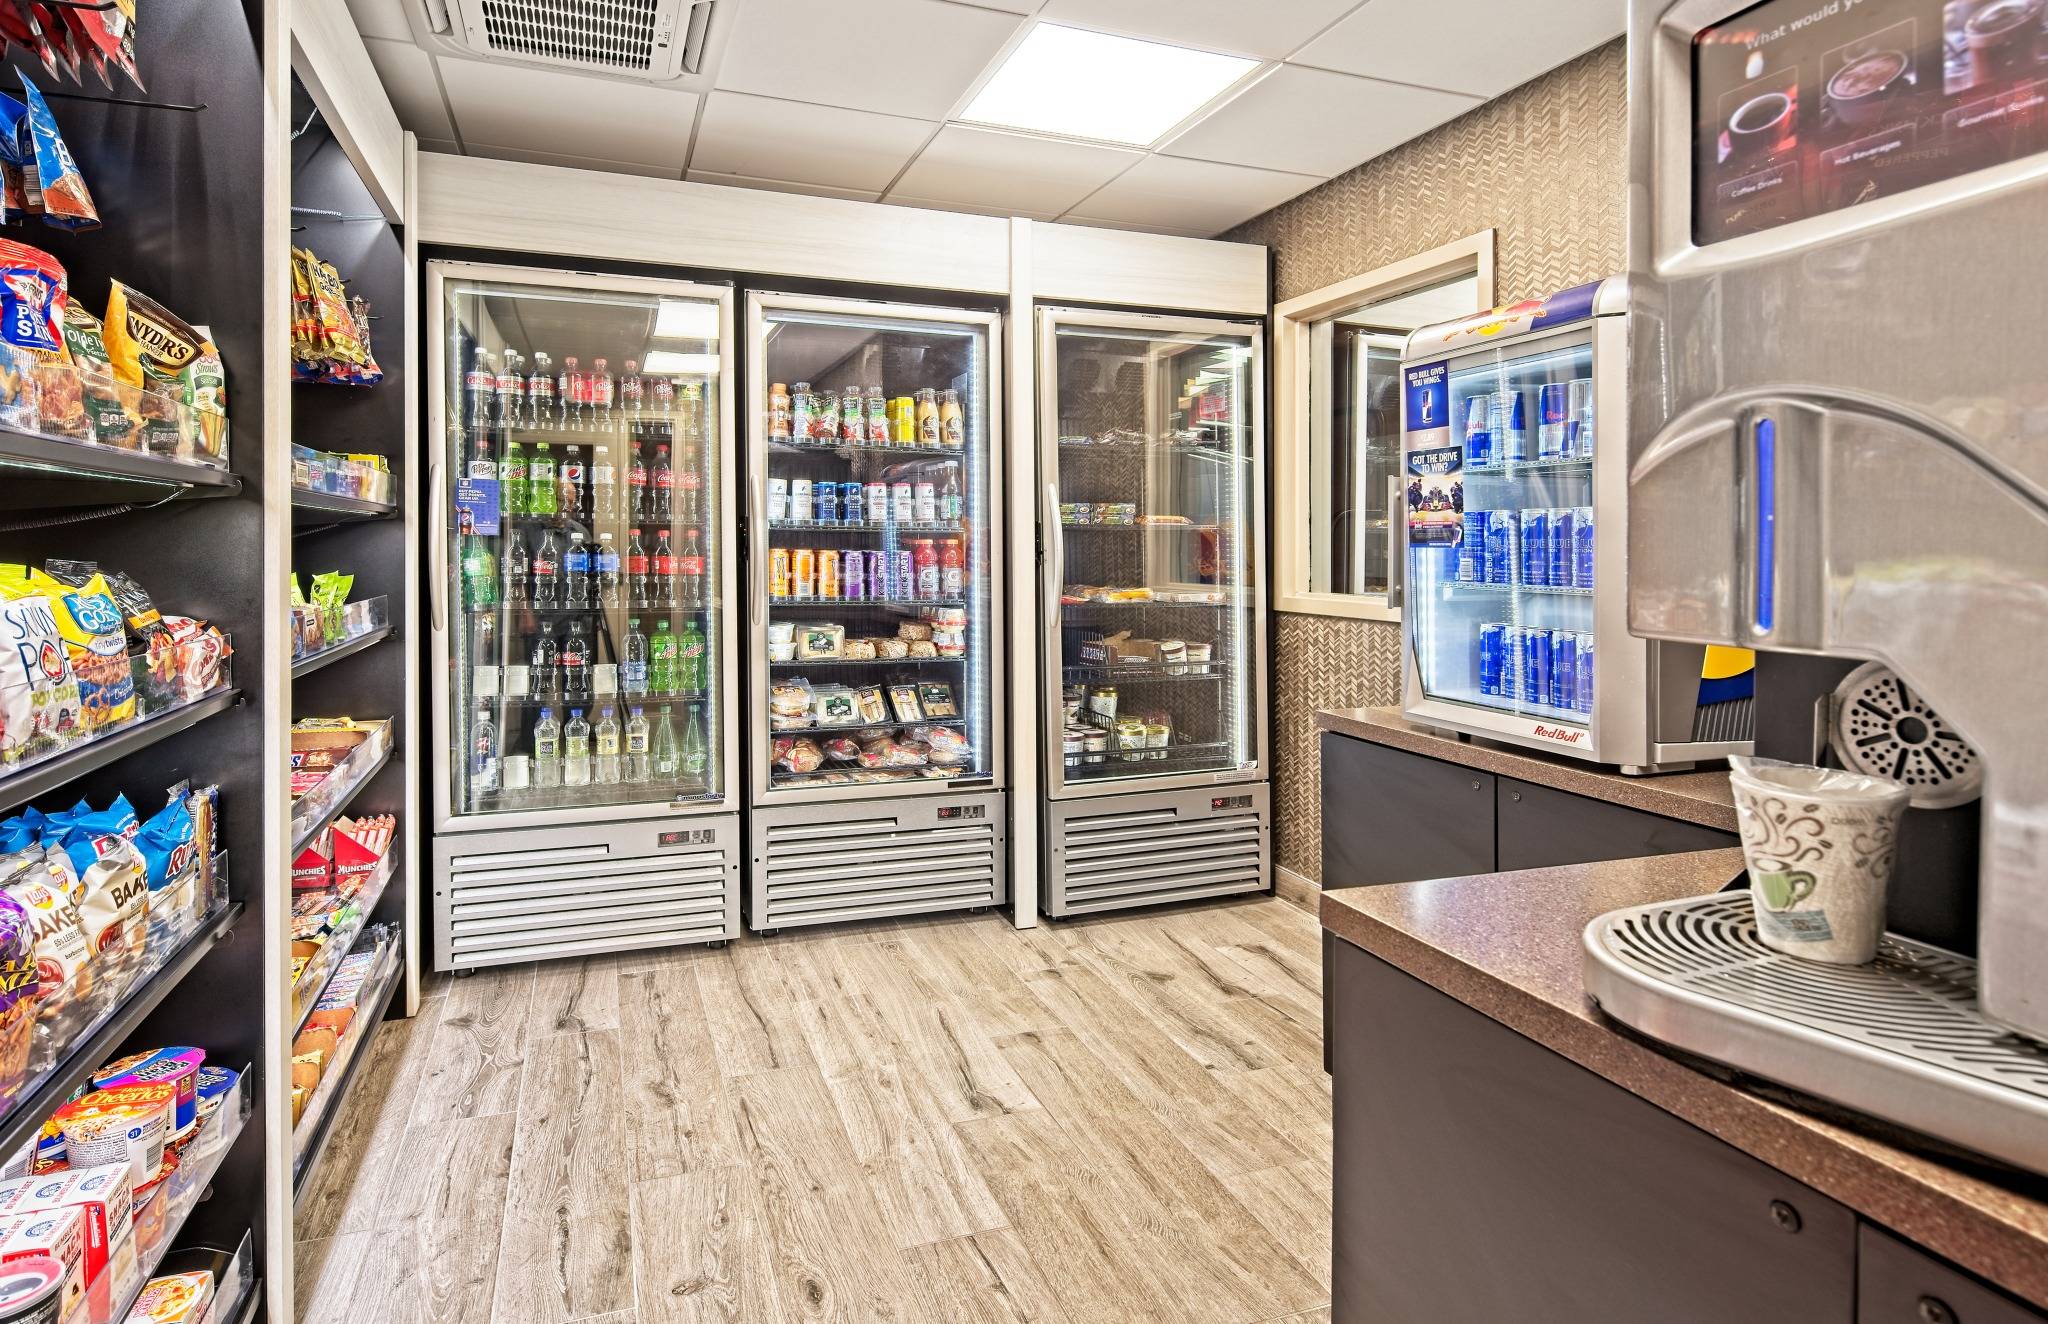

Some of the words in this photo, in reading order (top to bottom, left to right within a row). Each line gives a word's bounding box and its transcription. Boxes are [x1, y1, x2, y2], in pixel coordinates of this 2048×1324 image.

[1746, 25, 1787, 50] What
[1790, 1, 1840, 31] would
[1731, 186, 1757, 198] Coffee
[1408, 373, 1419, 381] RED
[1419, 369, 1430, 379] BULL
[1431, 366, 1445, 377] GIVES
[1412, 378, 1423, 388] YOU
[1412, 456, 1425, 465] GOT
[1427, 453, 1438, 463] THE
[1439, 451, 1458, 462] DRIVE
[1421, 464, 1430, 473] TO
[1431, 462, 1449, 473] WIN?
[877, 552, 885, 597] KICKSTART
[901, 552, 909, 597] KICKSTART
[1534, 725, 1557, 740] Red
[1556, 729, 1580, 743] Bull
[337, 863, 378, 876] MUNCHIES
[34, 907, 79, 944] AKE
[80, 1089, 170, 1107] Cheerios
